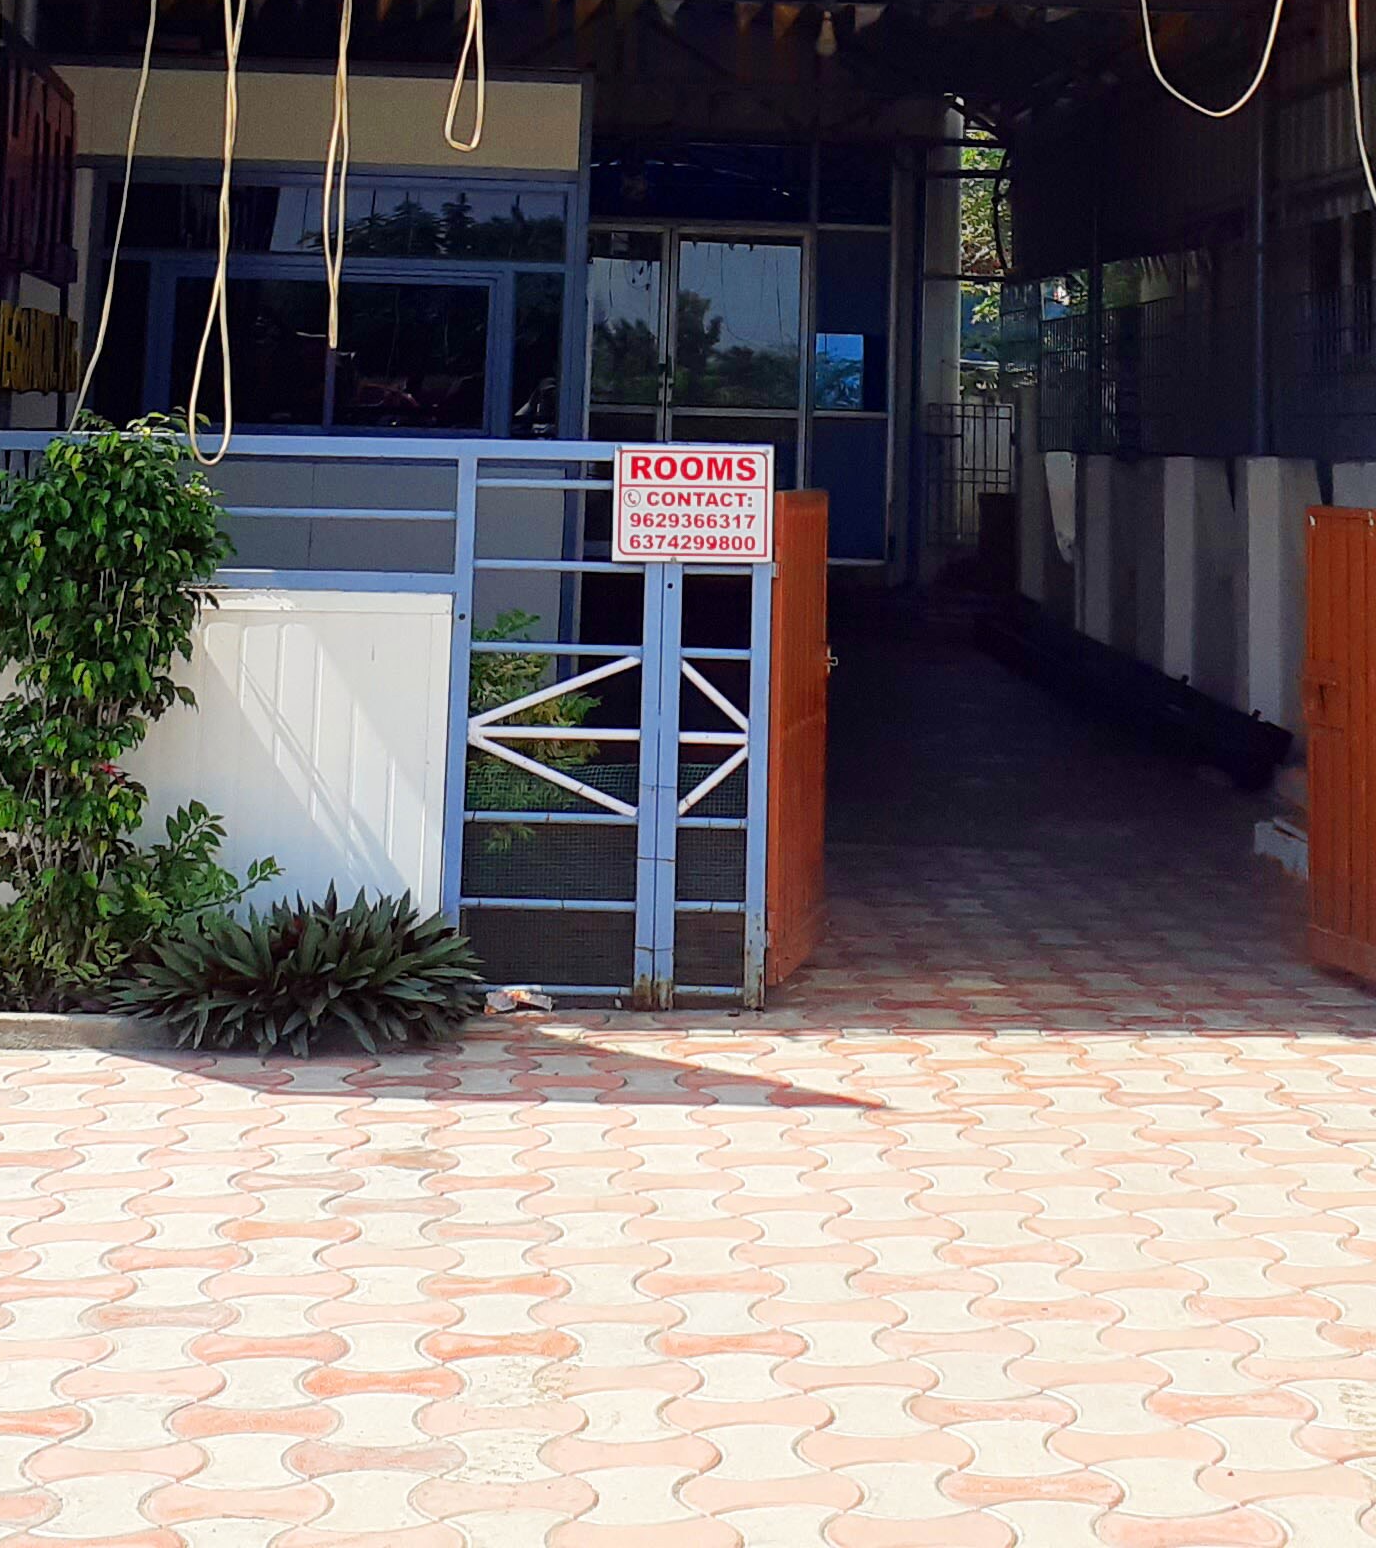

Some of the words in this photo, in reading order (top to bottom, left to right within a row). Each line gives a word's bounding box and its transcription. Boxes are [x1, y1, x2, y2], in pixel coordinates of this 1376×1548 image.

[630, 455, 757, 482] ROOMS
[646, 490, 753, 508] CONTACT:
[630, 512, 756, 530] 9629366317
[629, 534, 757, 551] 6374299800
